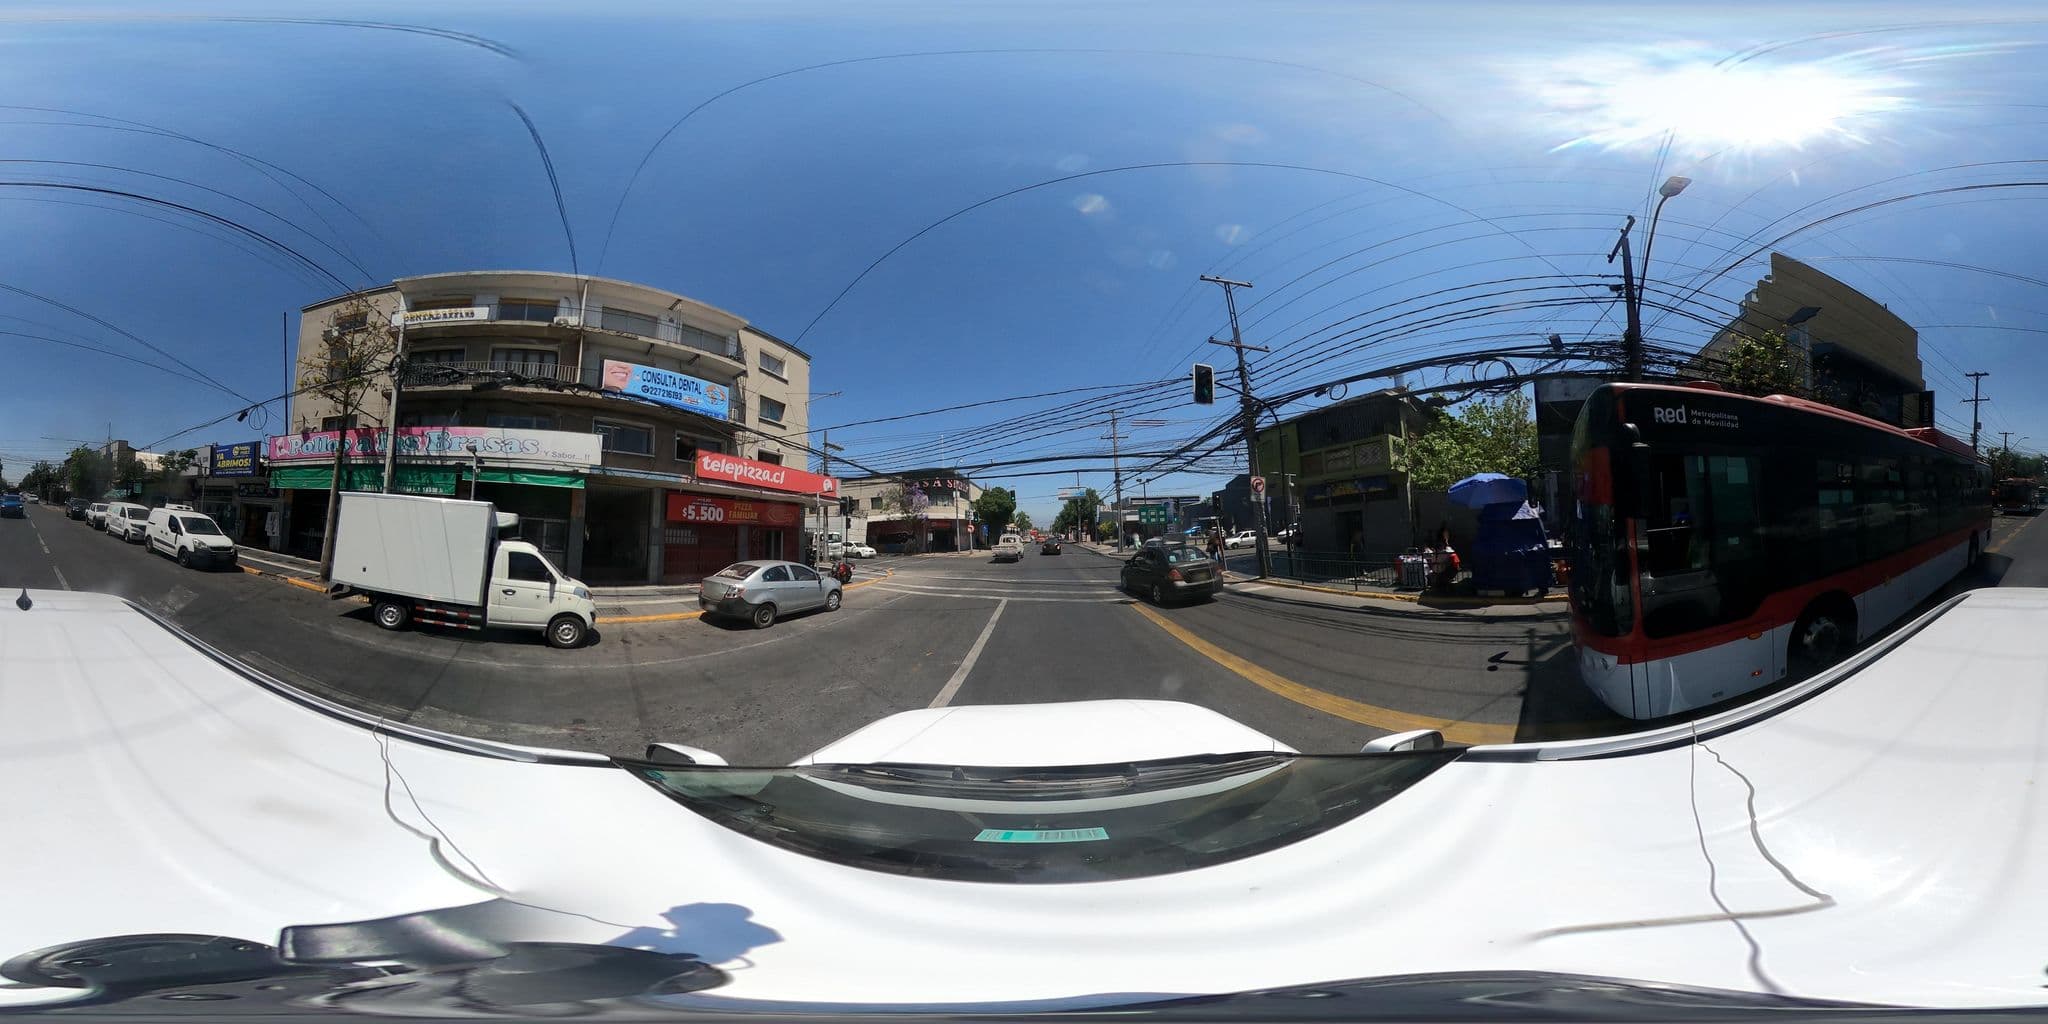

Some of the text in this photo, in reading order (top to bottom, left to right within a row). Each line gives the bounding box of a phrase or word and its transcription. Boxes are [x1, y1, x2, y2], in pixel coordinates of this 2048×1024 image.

[641, 370, 702, 395] CONSULTA DENTAL
[1654, 403, 1687, 424] Red
[1690, 410, 1738, 420] Metropolitana
[1704, 419, 1739, 428] Movilidad
[426, 429, 540, 455] Brasas
[216, 458, 252, 468] ABRIMOS!
[702, 455, 785, 484] telepizza.cl
[682, 503, 724, 522] $5.500
[734, 502, 753, 511] PIZZA
[728, 510, 759, 521] FAMILIAR
